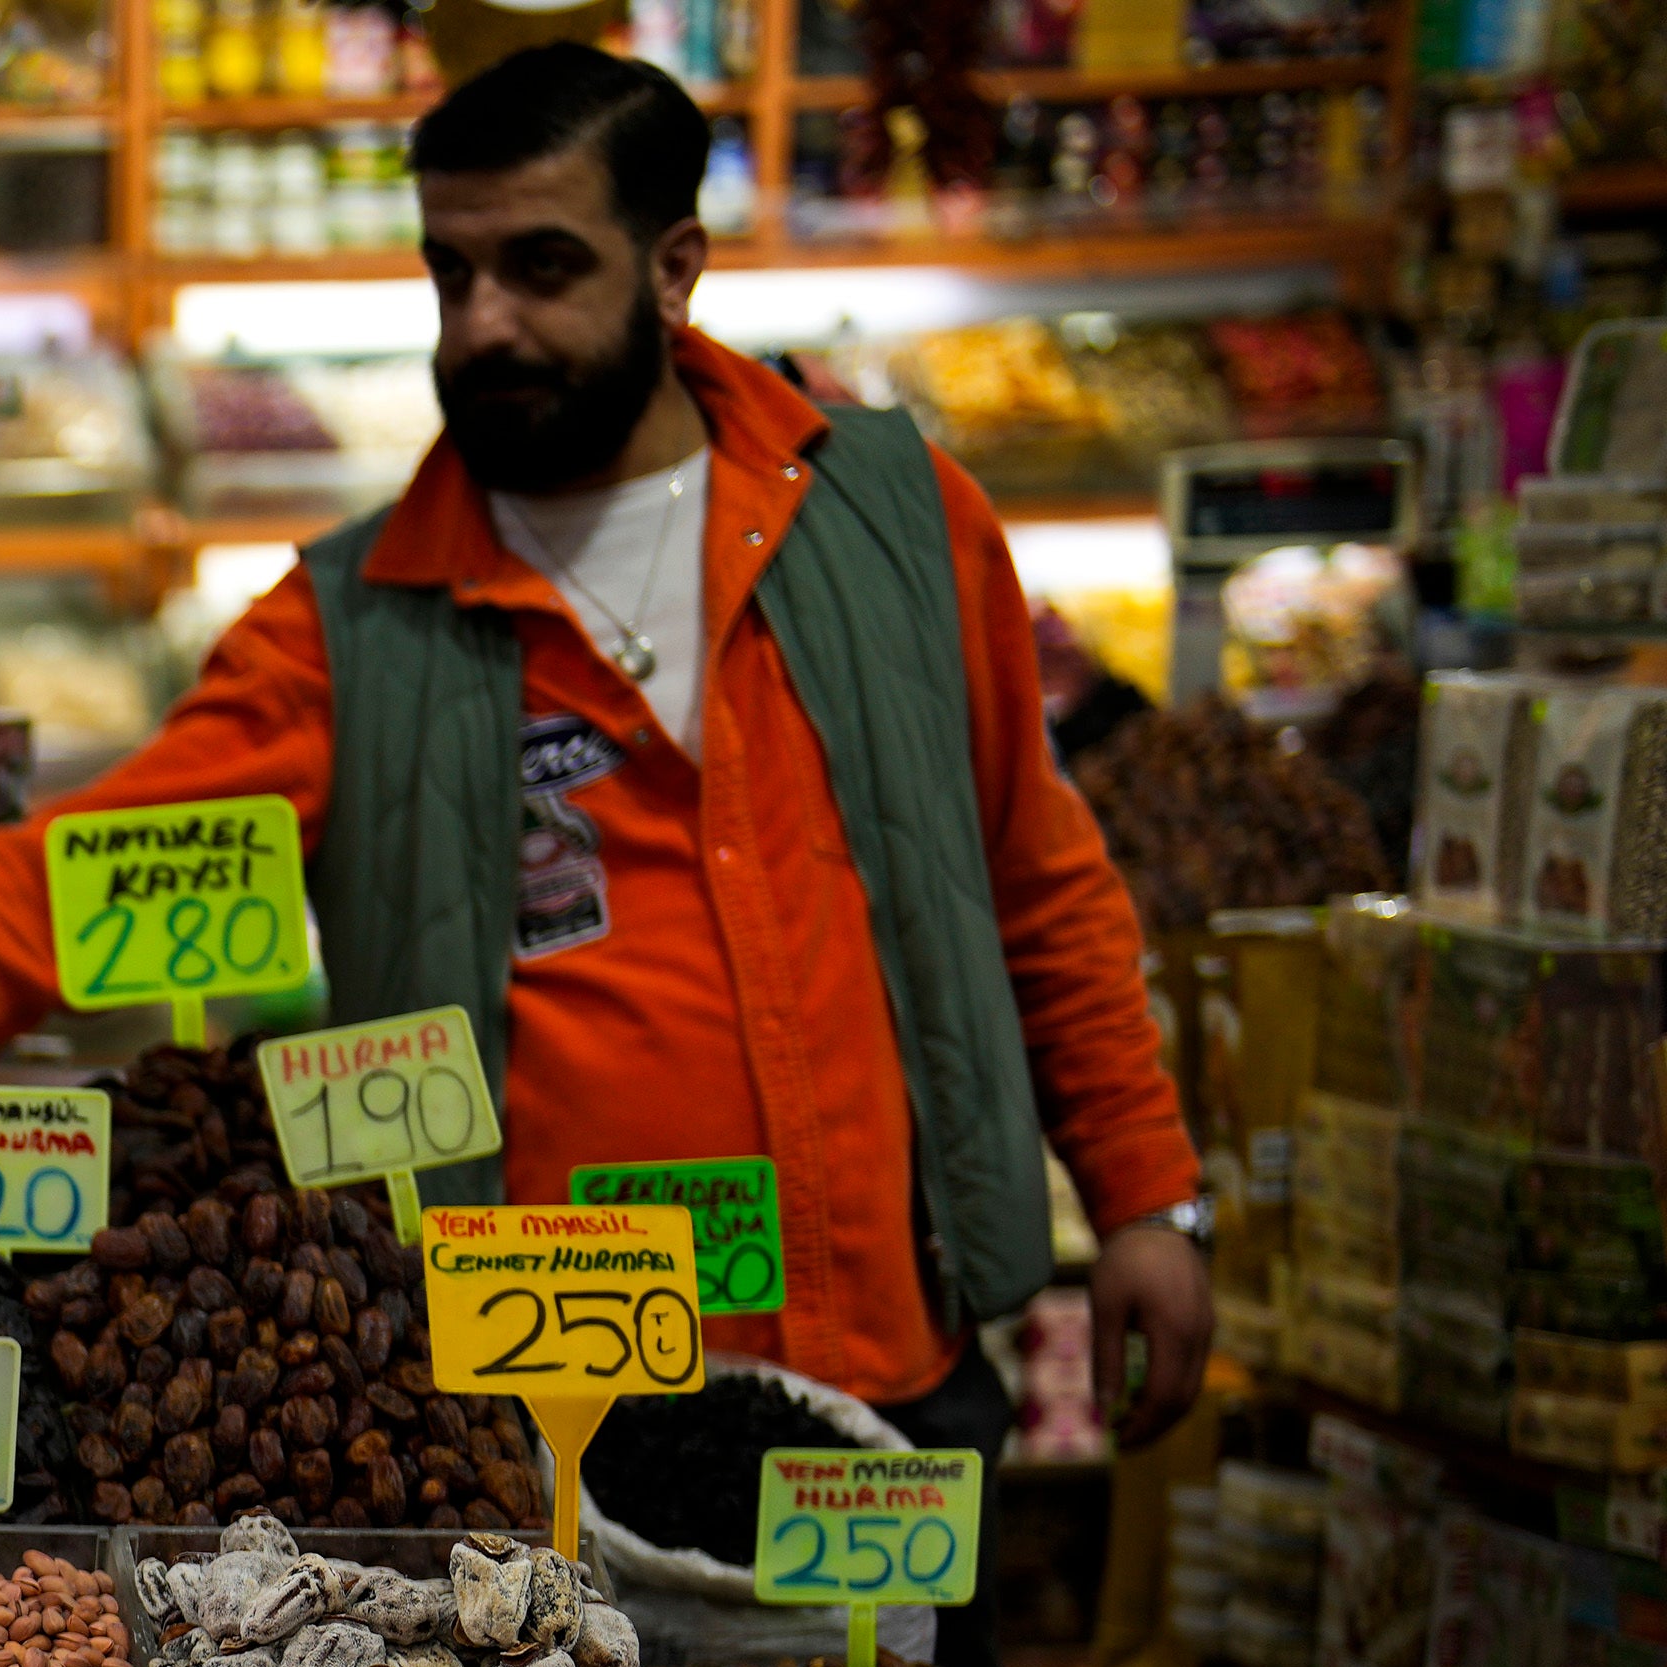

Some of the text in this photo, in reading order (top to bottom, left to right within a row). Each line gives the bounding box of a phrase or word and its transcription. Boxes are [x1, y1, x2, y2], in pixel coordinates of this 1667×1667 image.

[63, 818, 277, 860] NATUREL
[279, 1022, 452, 1085] HURMA
[289, 1065, 478, 1177] 190
[430, 1209, 498, 1238] YENİ
[429, 1242, 677, 1275] CENNET HURMASI
[472, 1285, 698, 1388] 250
[852, 1456, 966, 1484] MEDİNE
[794, 1485, 946, 1512] HURMA
[773, 1514, 958, 1592] 250
